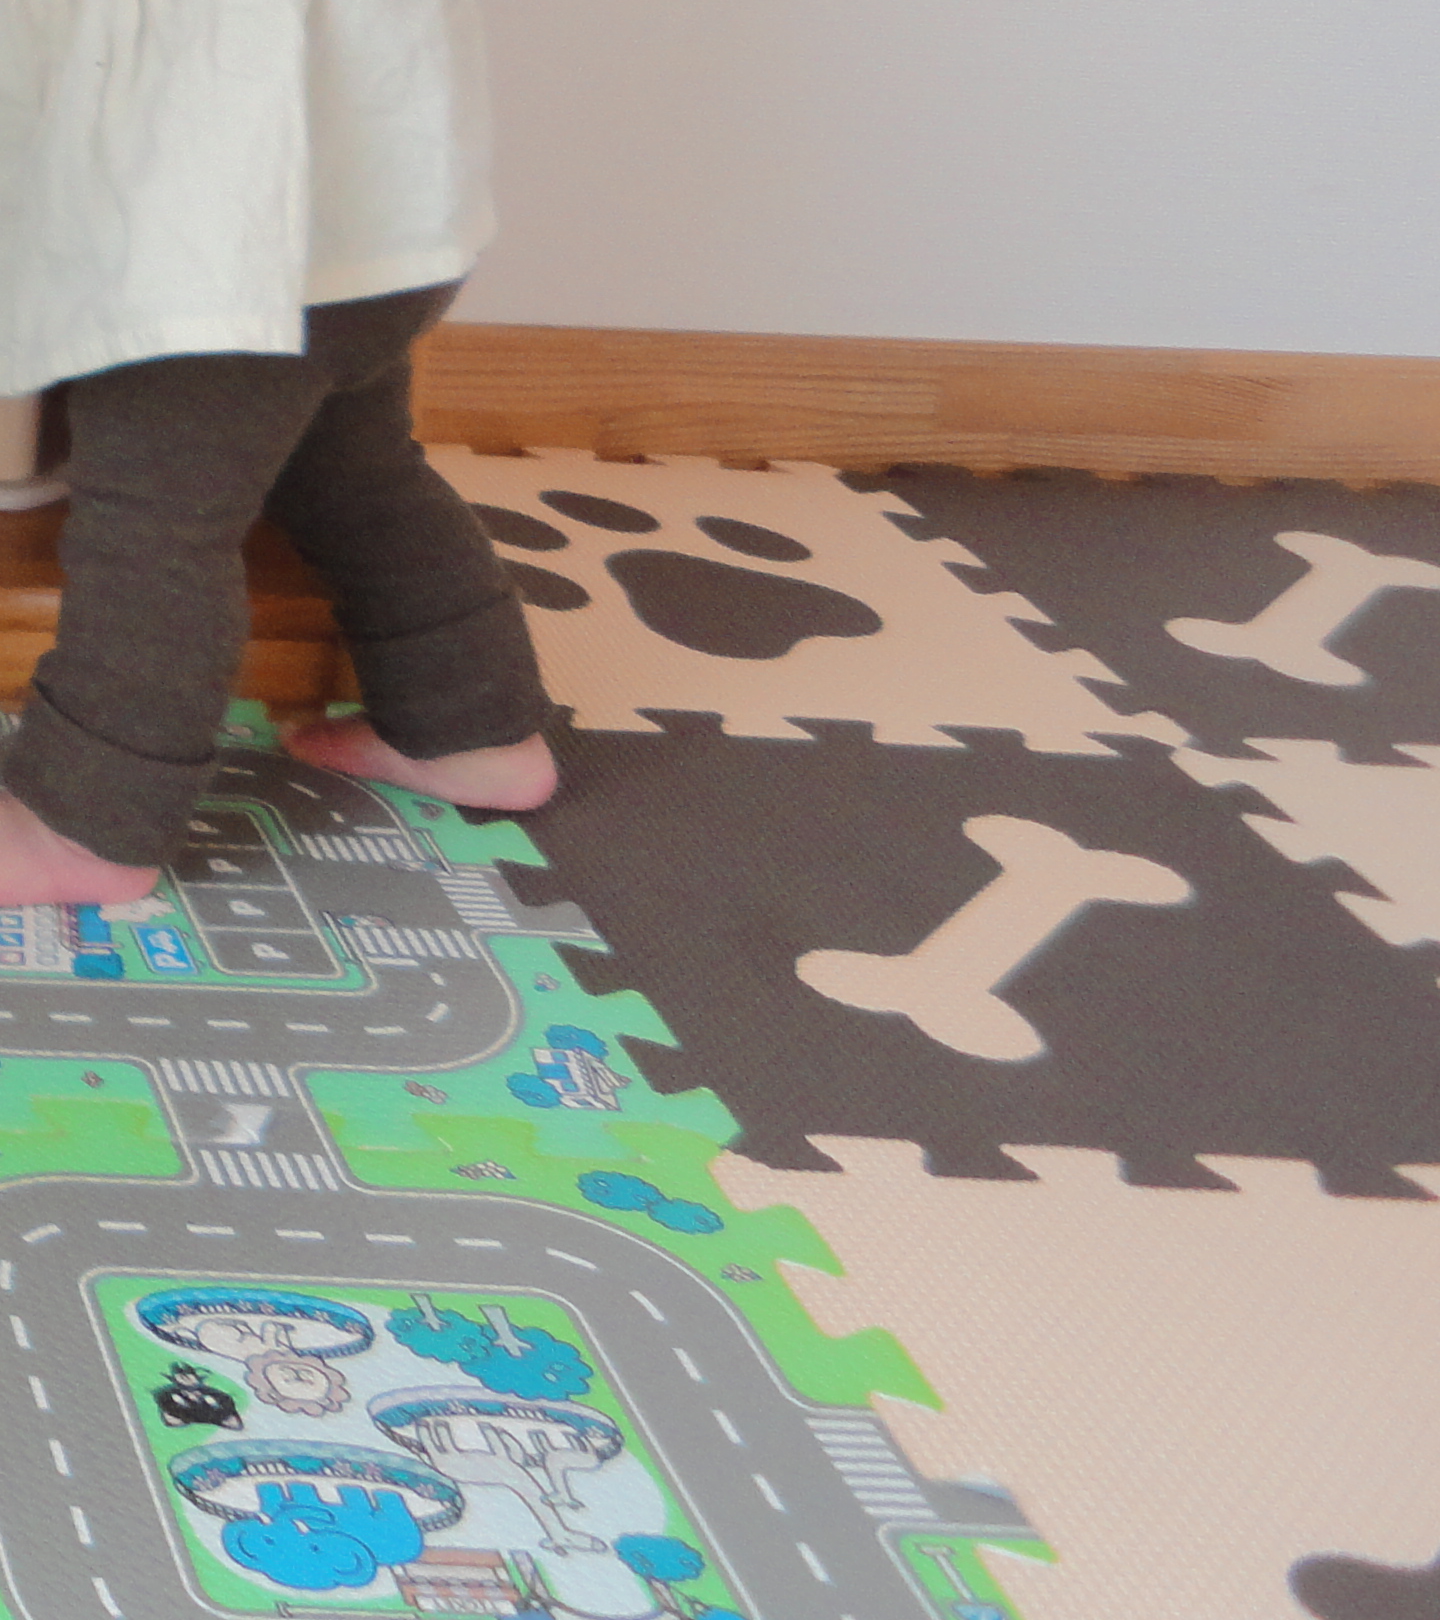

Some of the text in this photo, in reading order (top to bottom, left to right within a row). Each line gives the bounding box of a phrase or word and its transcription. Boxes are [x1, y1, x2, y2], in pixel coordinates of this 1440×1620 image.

[207, 858, 243, 874] P
[229, 899, 265, 916] P
[251, 942, 290, 960] P
